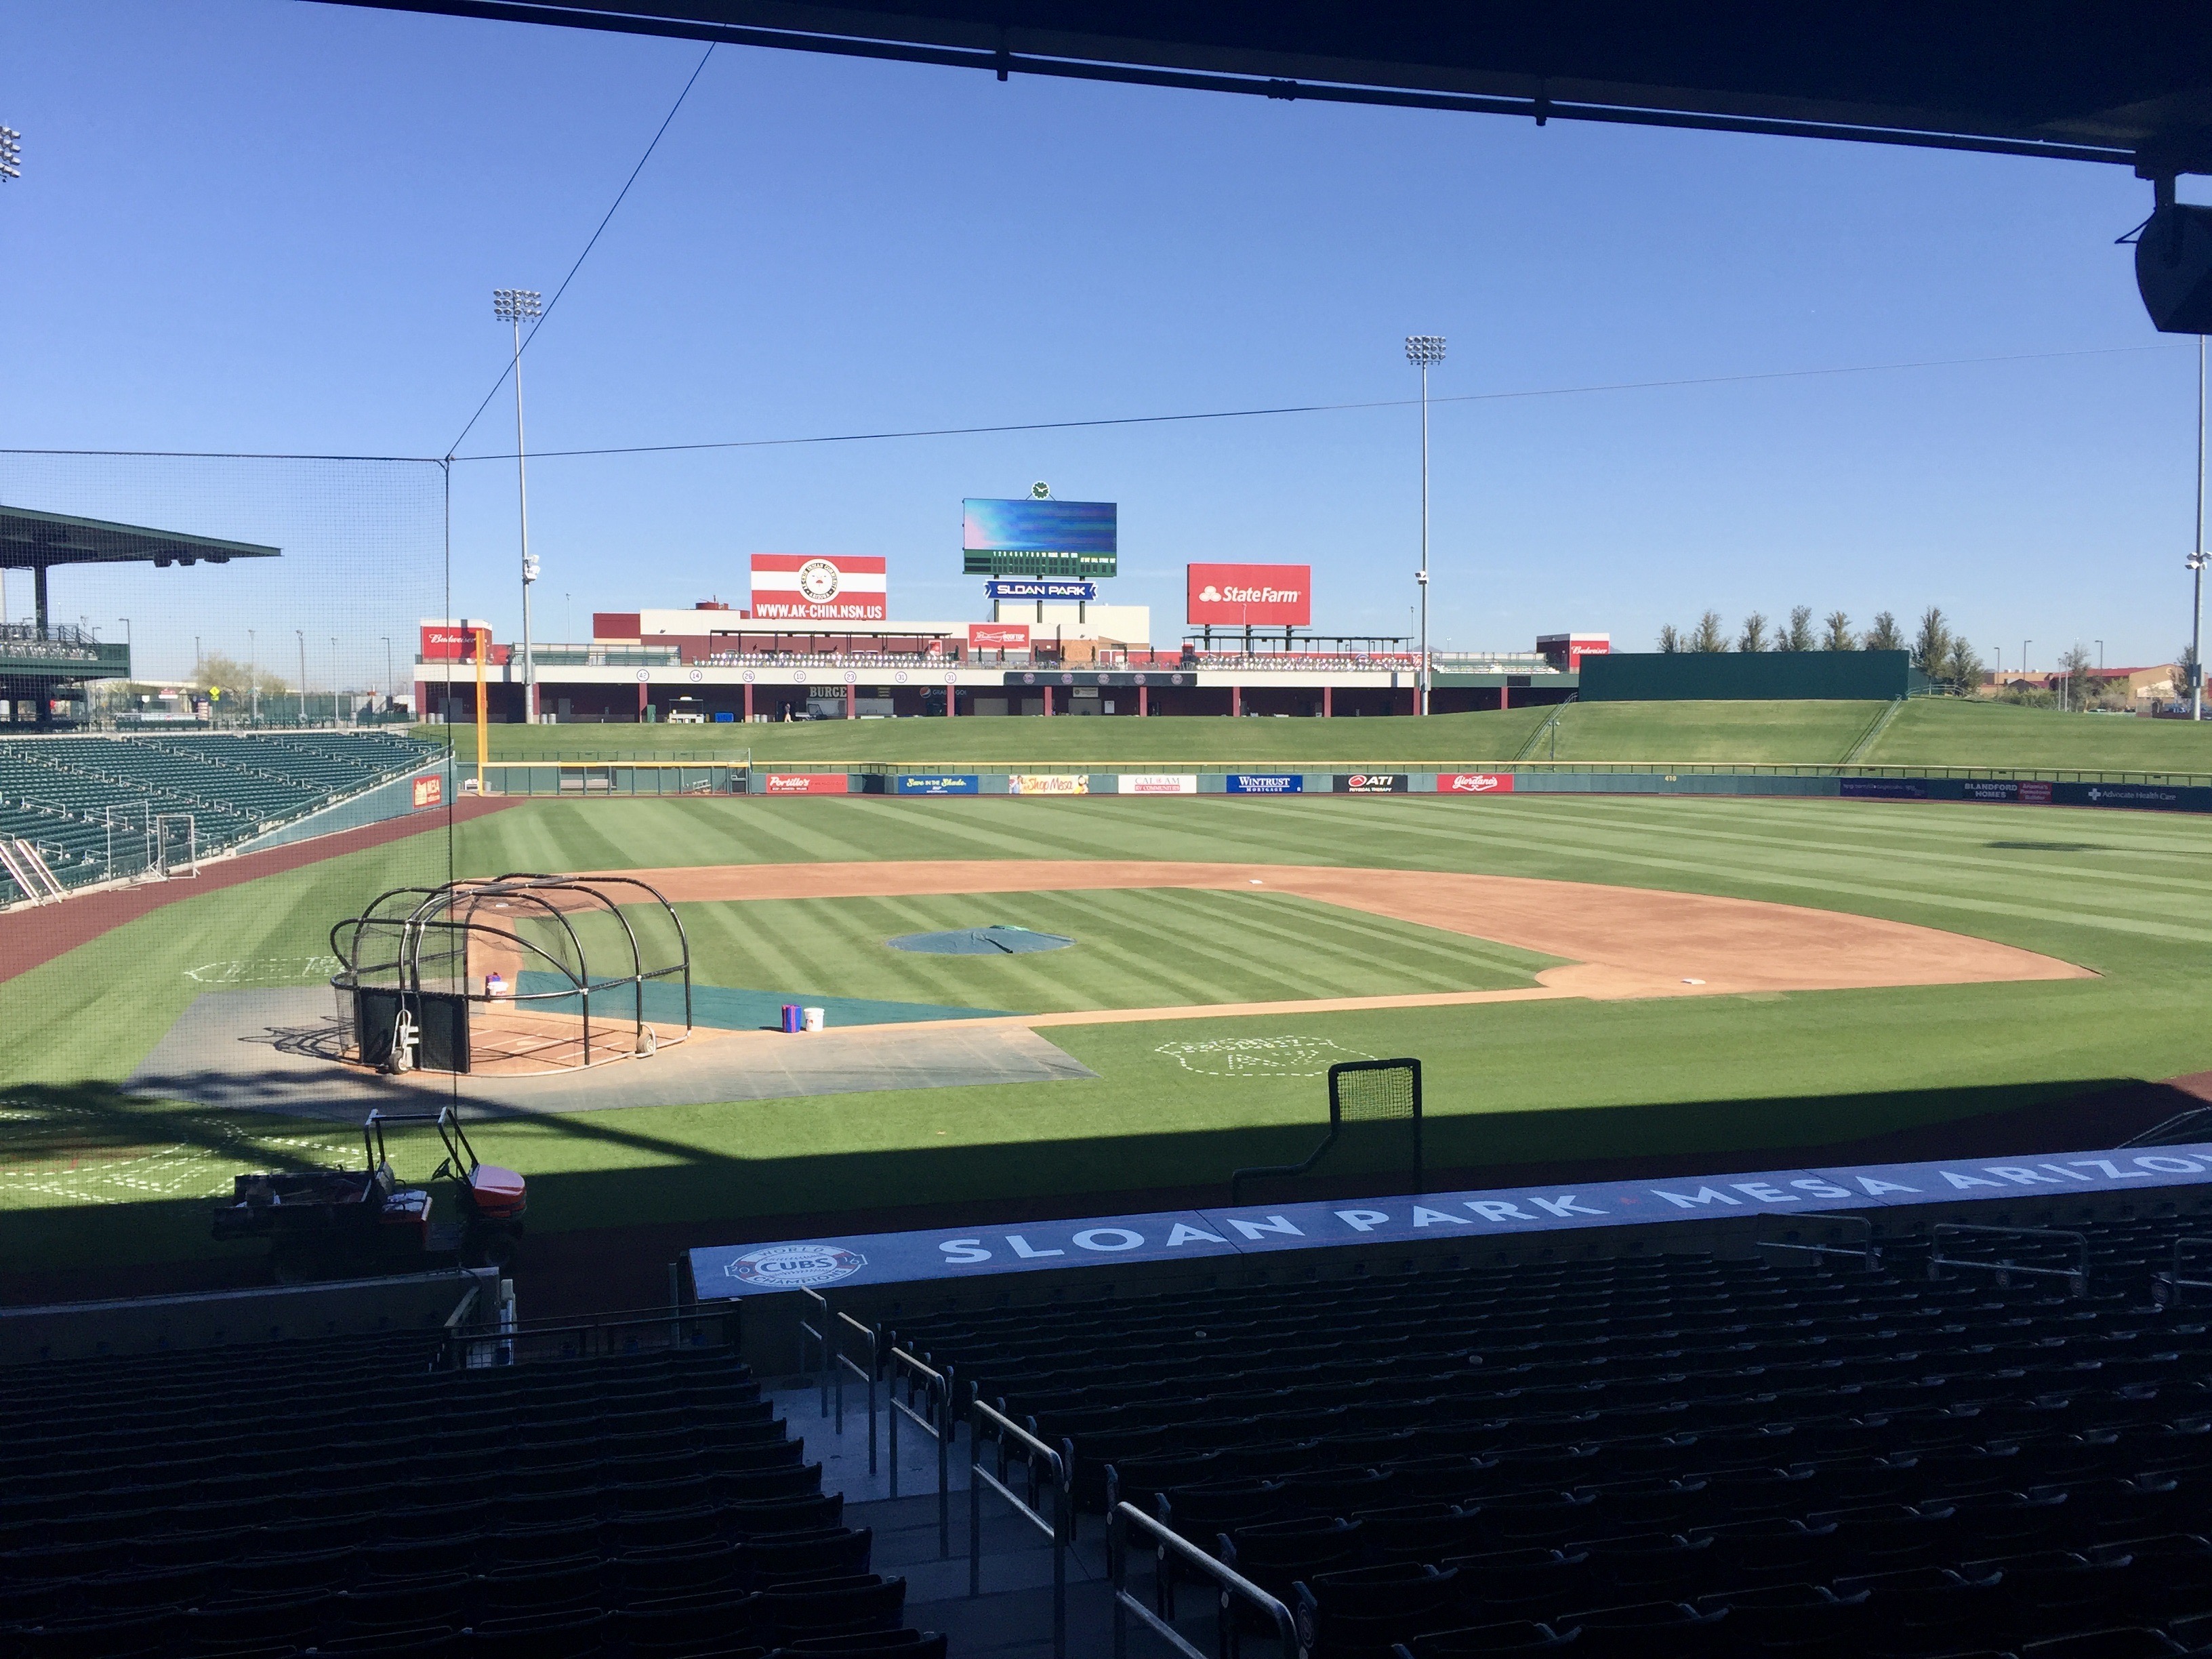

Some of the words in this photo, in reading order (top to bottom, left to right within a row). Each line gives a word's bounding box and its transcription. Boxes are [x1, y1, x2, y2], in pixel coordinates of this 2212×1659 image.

[997, 585, 1045, 594] SLOAN
[1048, 586, 1085, 596] PARK
[756, 604, 882, 618] WWW.AK-CHIN.NSN.US
[428, 634, 476, 643] Budweiser
[1572, 646, 1607, 654] Budweiser
[809, 687, 847, 697] BURGE
[769, 776, 811, 786] Portillo's
[1027, 778, 1048, 792] Shop
[1050, 777, 1073, 791] Mesa
[1239, 776, 1290, 785] WINTRUST
[1366, 776, 1393, 785] ATI
[1452, 775, 1498, 789] Giordano's
[427, 779, 440, 794] MESA
[1964, 783, 2018, 792] BLANDFORD
[2102, 790, 2135, 799] Advocate
[2136, 792, 2158, 800] Health
[939, 1215, 1306, 1264] SLOAN
[1334, 1195, 1610, 1231] PARK
[1650, 1176, 1922, 1208] MESA
[1940, 1153, 2212, 1189] ARIZO
[760, 1246, 825, 1256] WORLD
[760, 1257, 829, 1273] CUBS
[753, 1269, 848, 1285] CHAMPIONS
